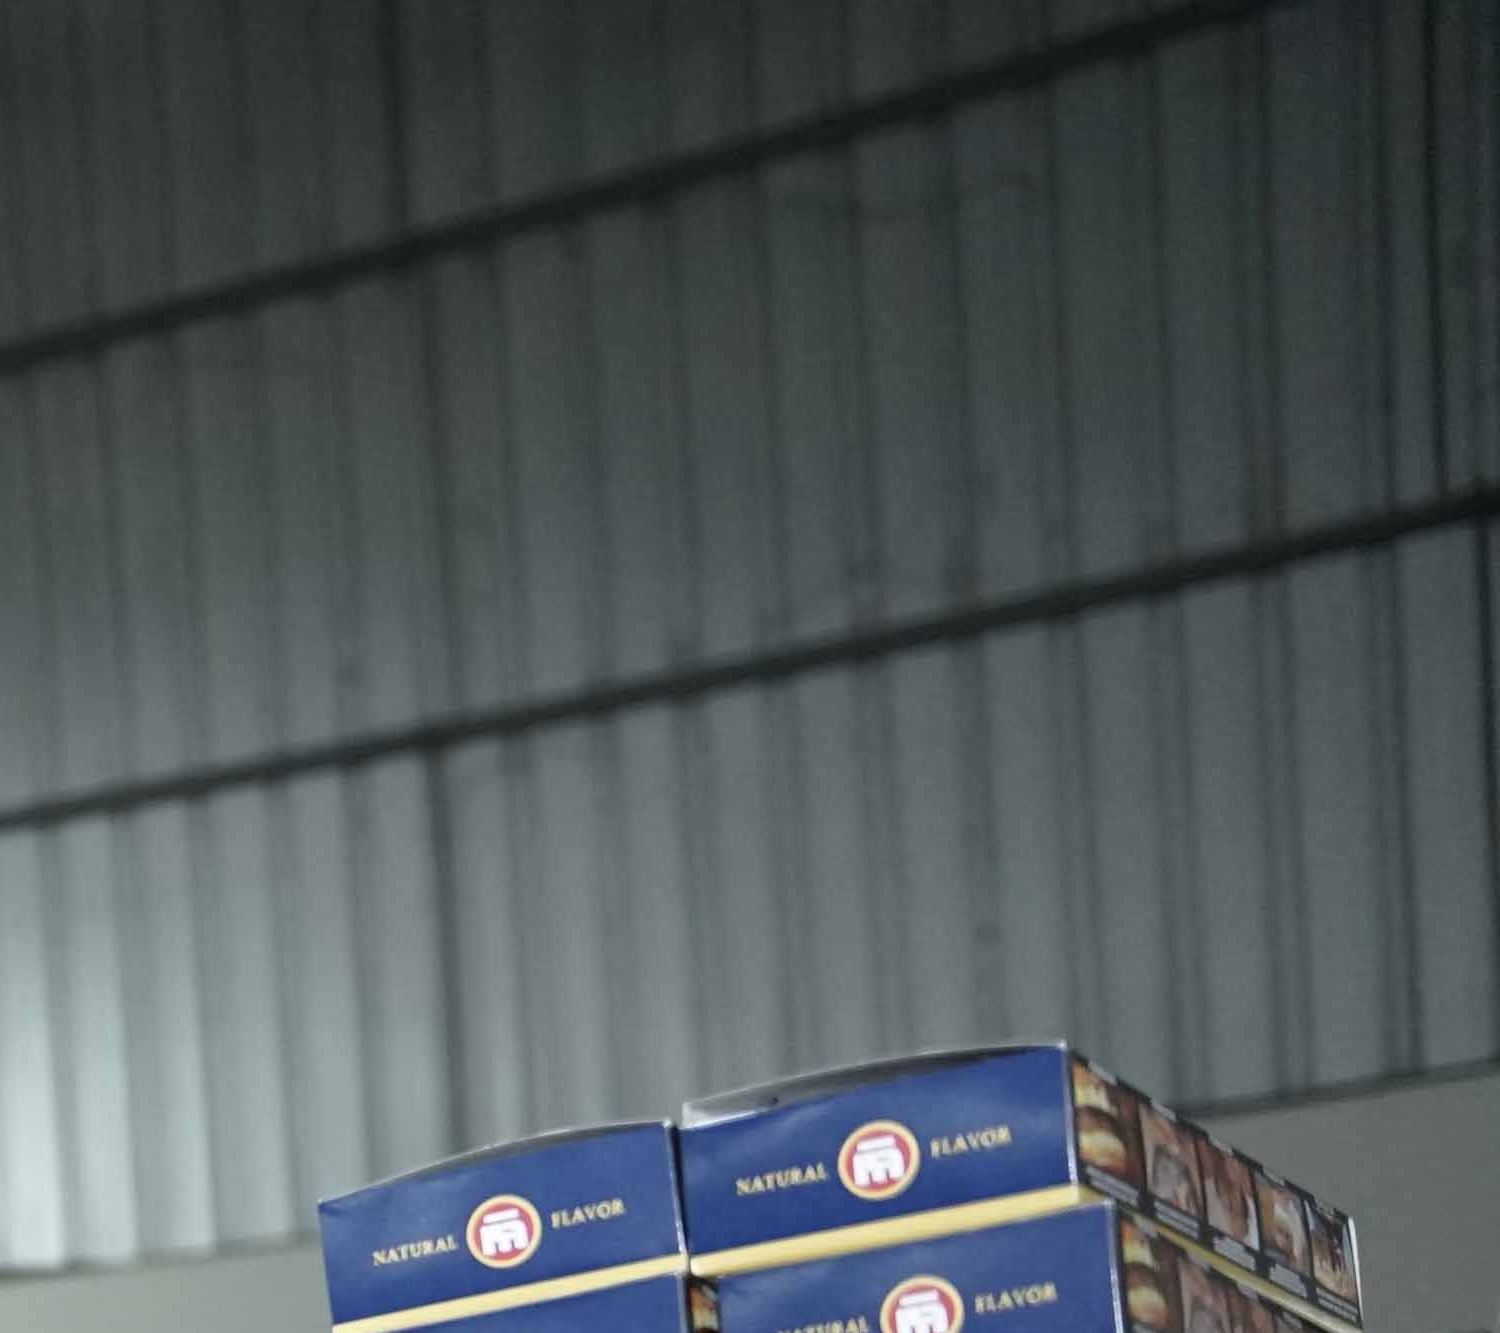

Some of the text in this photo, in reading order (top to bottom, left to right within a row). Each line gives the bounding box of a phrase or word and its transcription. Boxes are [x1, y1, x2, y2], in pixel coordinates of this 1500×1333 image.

[735, 1127, 1011, 1194] NATURAL FLAVOR
[373, 1200, 624, 1266] NATURAL FLAVOR
[974, 1284, 1056, 1314] FLAVOR
